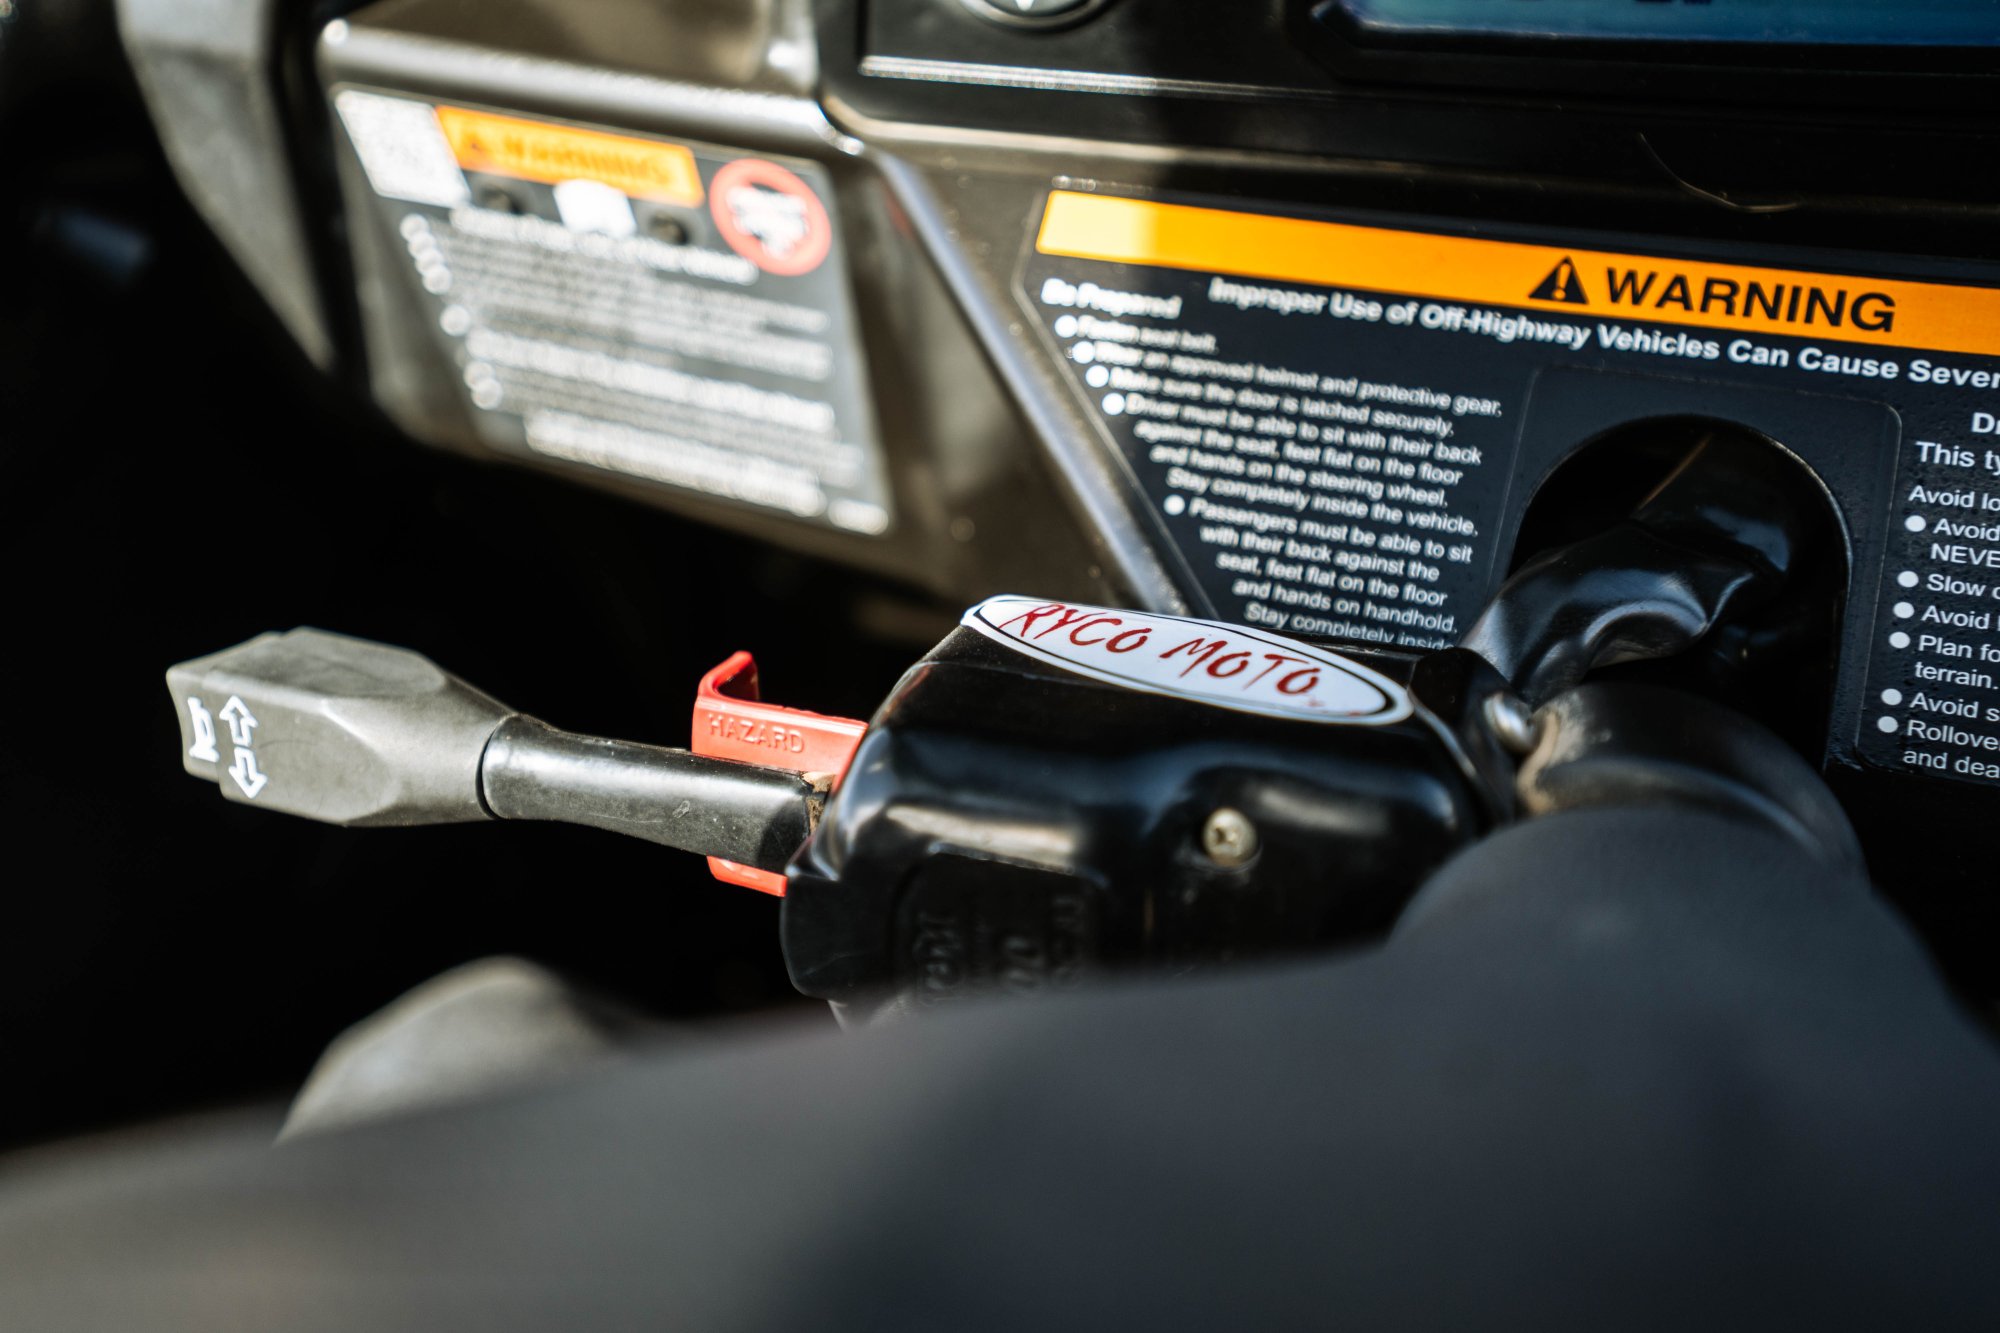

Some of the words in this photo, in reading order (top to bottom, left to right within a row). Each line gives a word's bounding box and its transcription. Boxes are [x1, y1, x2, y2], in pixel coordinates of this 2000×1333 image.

[1076, 282, 1183, 319] Prepared
[1606, 267, 1897, 333] WARNING
[1208, 276, 1329, 316] Improper
[1329, 291, 1383, 322] Use
[1385, 300, 1420, 326] of
[1419, 302, 1592, 350] Off-Highway
[1598, 323, 1720, 360] Vehicles
[1727, 338, 1790, 368] Can
[1798, 347, 1900, 379] Cause
[1908, 358, 2000, 389] Sever
[1142, 352, 1170, 369] an
[1169, 354, 1255, 382] approved
[1255, 364, 1319, 391] helmet
[1318, 376, 1358, 397] and
[1357, 381, 1451, 409] protective
[1109, 366, 1162, 394] Make
[1161, 378, 1203, 399] sure
[1203, 382, 1235, 405] the
[1235, 387, 1280, 410] door
[1279, 393, 1299, 415] is
[1300, 396, 1371, 424] latched
[1371, 408, 1454, 439] securely.
[1134, 419, 1202, 445] against
[1201, 428, 1234, 450] the
[1322, 446, 1354, 470] flat
[1353, 455, 1381, 473] on
[1383, 457, 1416, 479] the
[1417, 460, 1463, 485] floor
[1180, 404, 1228, 427] must
[1227, 409, 1255, 432] be
[1254, 415, 1297, 438] able
[1297, 421, 1319, 441] to
[1319, 426, 1345, 446] sit
[1345, 430, 1387, 452] with
[1387, 434, 1433, 458] their
[1433, 439, 1482, 466] back
[1915, 441, 1976, 468] This
[1150, 444, 1189, 466] and
[1189, 448, 1246, 476] hands
[1246, 460, 1273, 480] on
[1273, 463, 1306, 486] the
[1306, 470, 1384, 501] steering
[1385, 482, 1448, 508] wheel.
[1166, 466, 1210, 495] Stay
[1210, 477, 1311, 513] completely
[1310, 493, 1369, 519] inside
[1369, 502, 1403, 524] the
[1405, 510, 1478, 537] vehicle.
[1908, 485, 1975, 508] Avoid
[1981, 493, 2000, 512] lo
[1188, 496, 1298, 534] Passengers
[1299, 520, 1349, 542] must
[1349, 524, 1376, 547] be
[1378, 531, 1421, 555] able
[1424, 538, 1445, 559] to
[1447, 544, 1473, 565] sit
[1932, 518, 2000, 541] Avoid
[1200, 526, 1239, 547] with
[1239, 528, 1285, 554] their
[1286, 534, 1332, 563] back
[1333, 550, 1405, 575] against
[1407, 559, 1440, 583] the
[1930, 543, 2000, 568] NEVE
[1265, 557, 1303, 582] feet
[1305, 564, 1337, 587] flat
[1338, 573, 1364, 592] on
[1367, 575, 1399, 598] the
[1402, 580, 1448, 607] floor
[1926, 573, 1987, 597] Slow
[1232, 577, 1272, 599] and
[1272, 583, 1331, 611] hands
[1334, 595, 1361, 615] on
[1363, 599, 1458, 635] handhold.
[1244, 601, 1290, 629] Stay
[1921, 605, 1990, 629] Avoid
[999, 604, 1152, 653] RYCO
[1159, 638, 1322, 695] MOTO
[1918, 634, 1973, 659] Plan
[1980, 644, 2000, 663] fo
[1914, 661, 1999, 690] terrain.
[1909, 692, 1979, 719] Avoid
[709, 712, 805, 754] HAZARD
[1907, 719, 2000, 752] Rollove
[1903, 750, 1948, 769] and
[1954, 756, 2000, 779] dea
